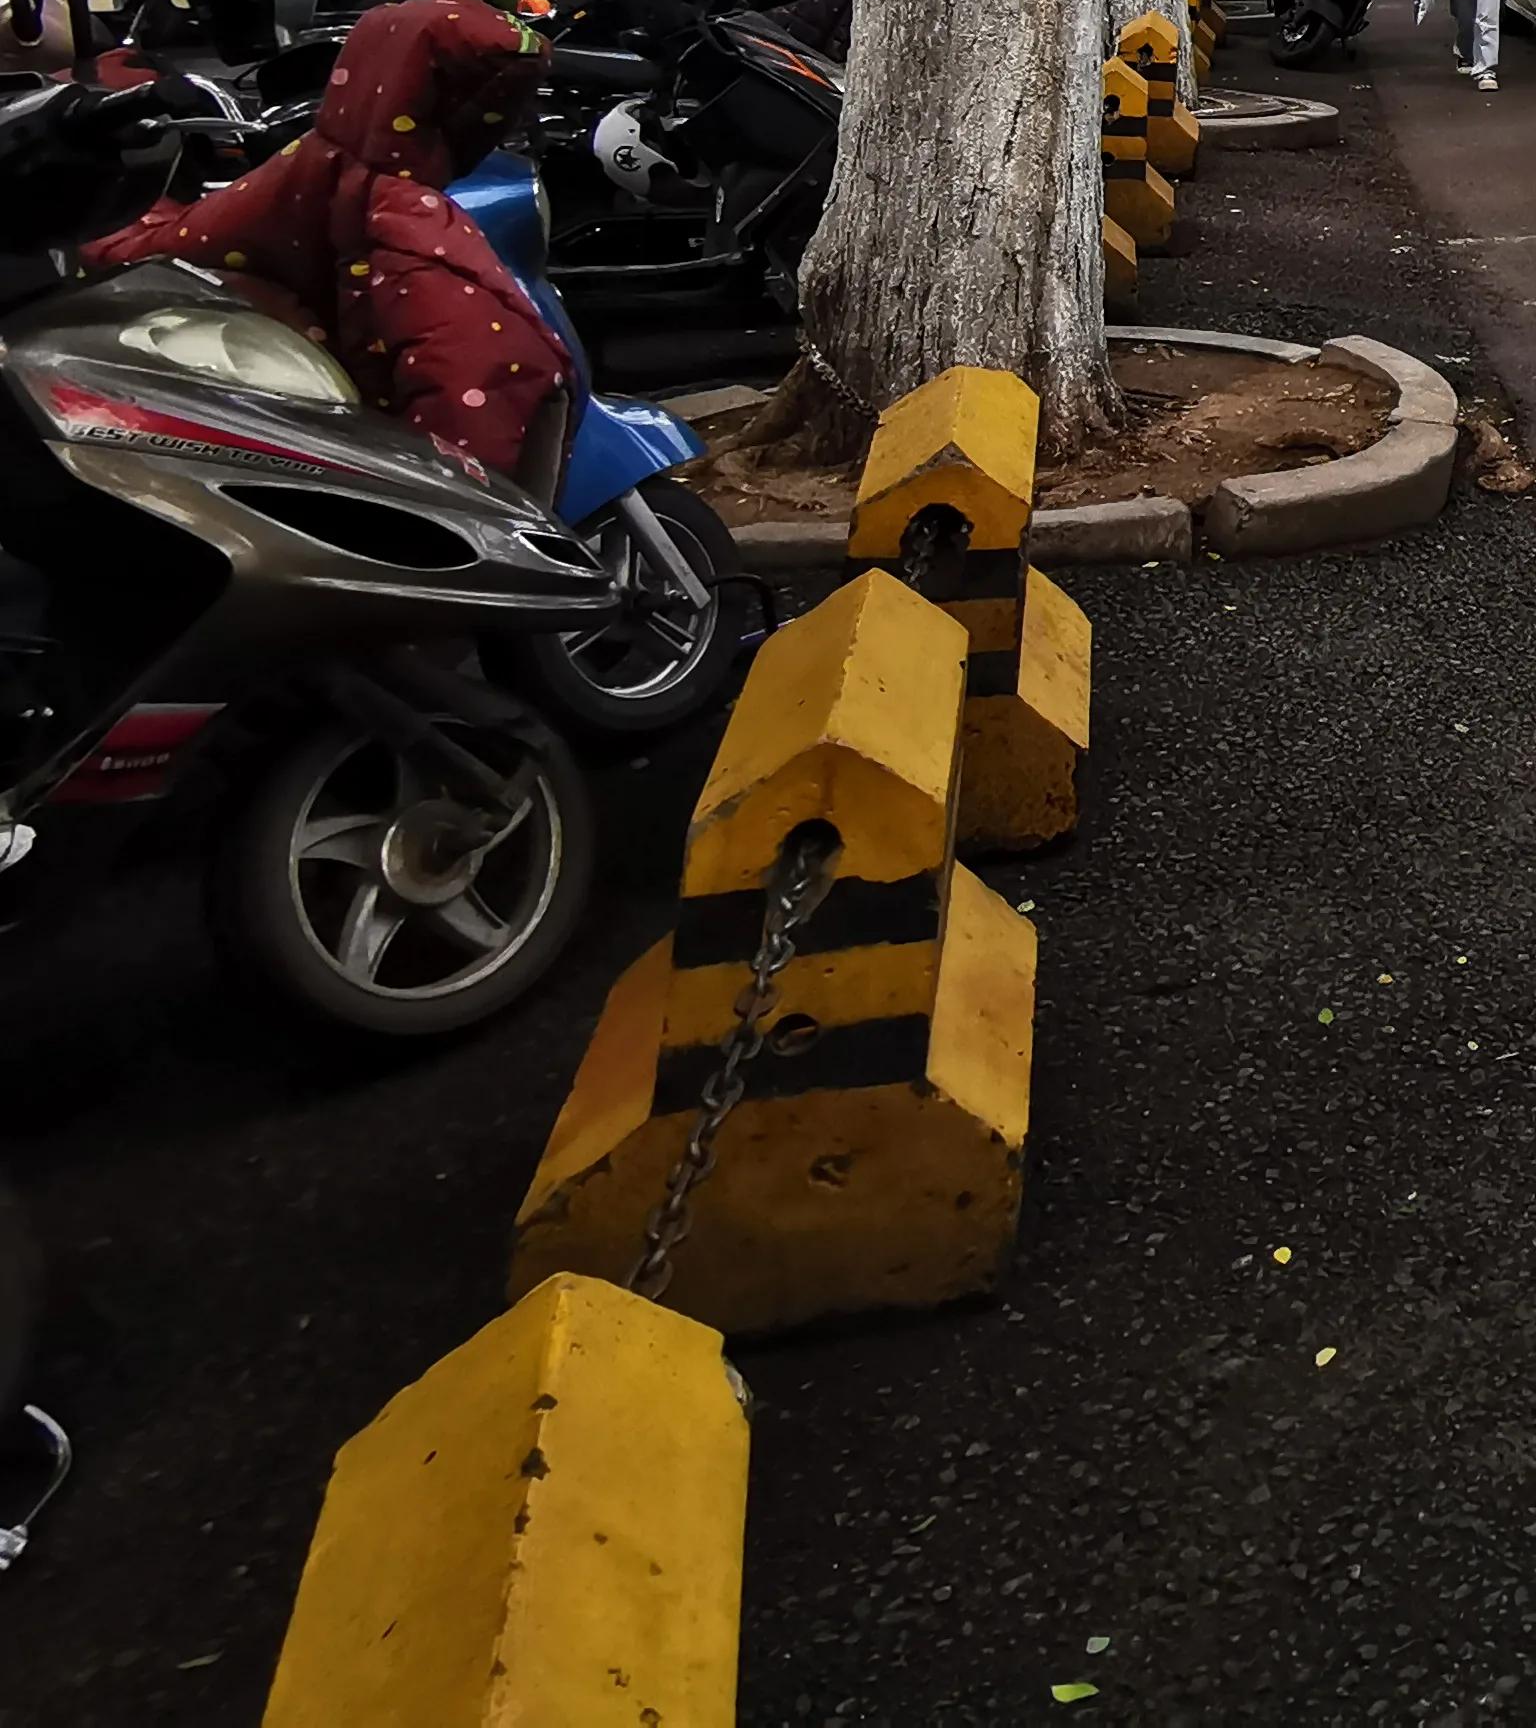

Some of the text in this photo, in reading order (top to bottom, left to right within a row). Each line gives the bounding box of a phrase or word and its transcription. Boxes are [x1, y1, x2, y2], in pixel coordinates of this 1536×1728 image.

[68, 423, 139, 444] BEST
[149, 434, 219, 457] WISH
[228, 447, 262, 464] TO
